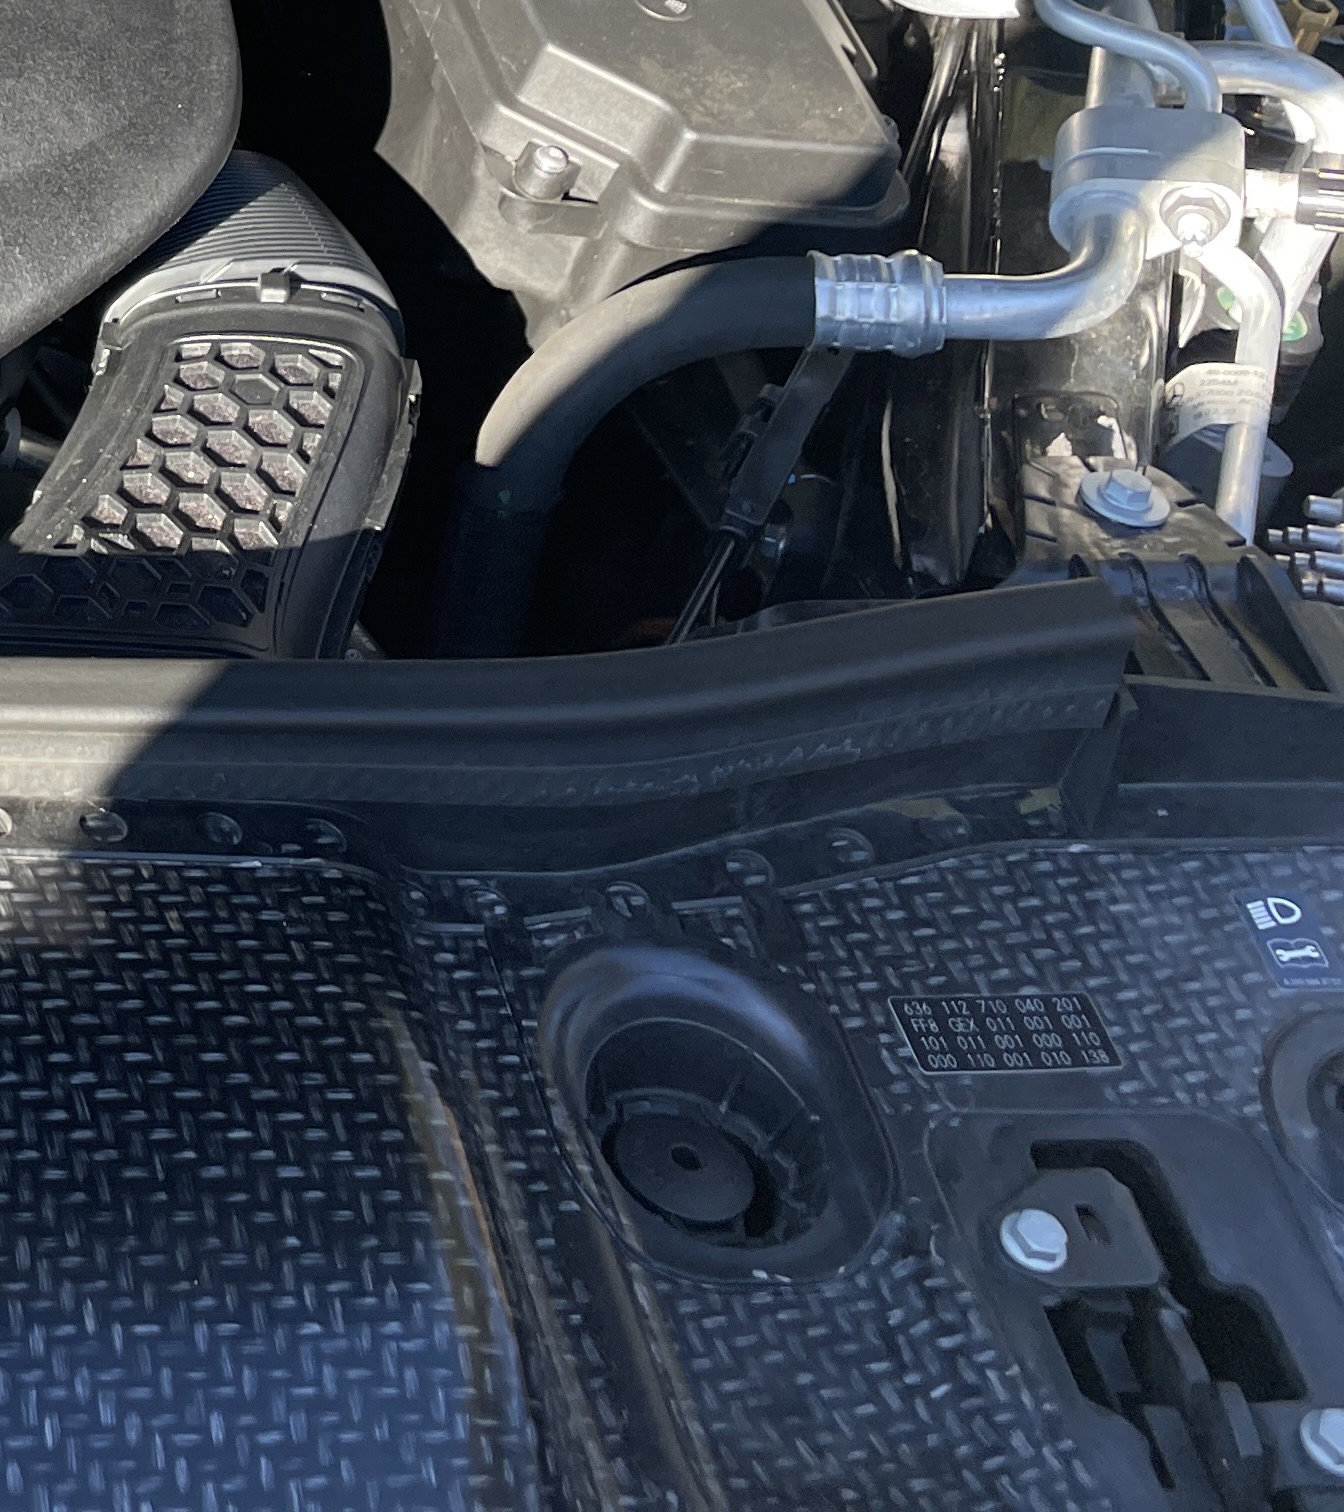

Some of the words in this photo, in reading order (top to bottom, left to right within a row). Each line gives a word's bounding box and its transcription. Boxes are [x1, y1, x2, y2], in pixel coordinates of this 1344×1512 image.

[904, 1001, 932, 1015] 636
[942, 1000, 970, 1015] 112
[976, 999, 1007, 1014] 710
[1015, 998, 1044, 1013] 040
[1052, 997, 1081, 1011] 201
[911, 1018, 939, 1033] FF8
[948, 1017, 980, 1032] GEX
[986, 1016, 1016, 1031] 011
[1024, 1015, 1053, 1030] 001
[1061, 1014, 1090, 1029] 001
[921, 1036, 948, 1050] 101
[957, 1035, 986, 1049] 011
[994, 1034, 1023, 1049] 001
[1032, 1033, 1062, 1048] 000
[1072, 1031, 1100, 1046] 110
[928, 1053, 957, 1068] 000
[967, 1053, 995, 1067] 110
[1003, 1052, 1033, 1067] 001
[1040, 1051, 1071, 1066] 010
